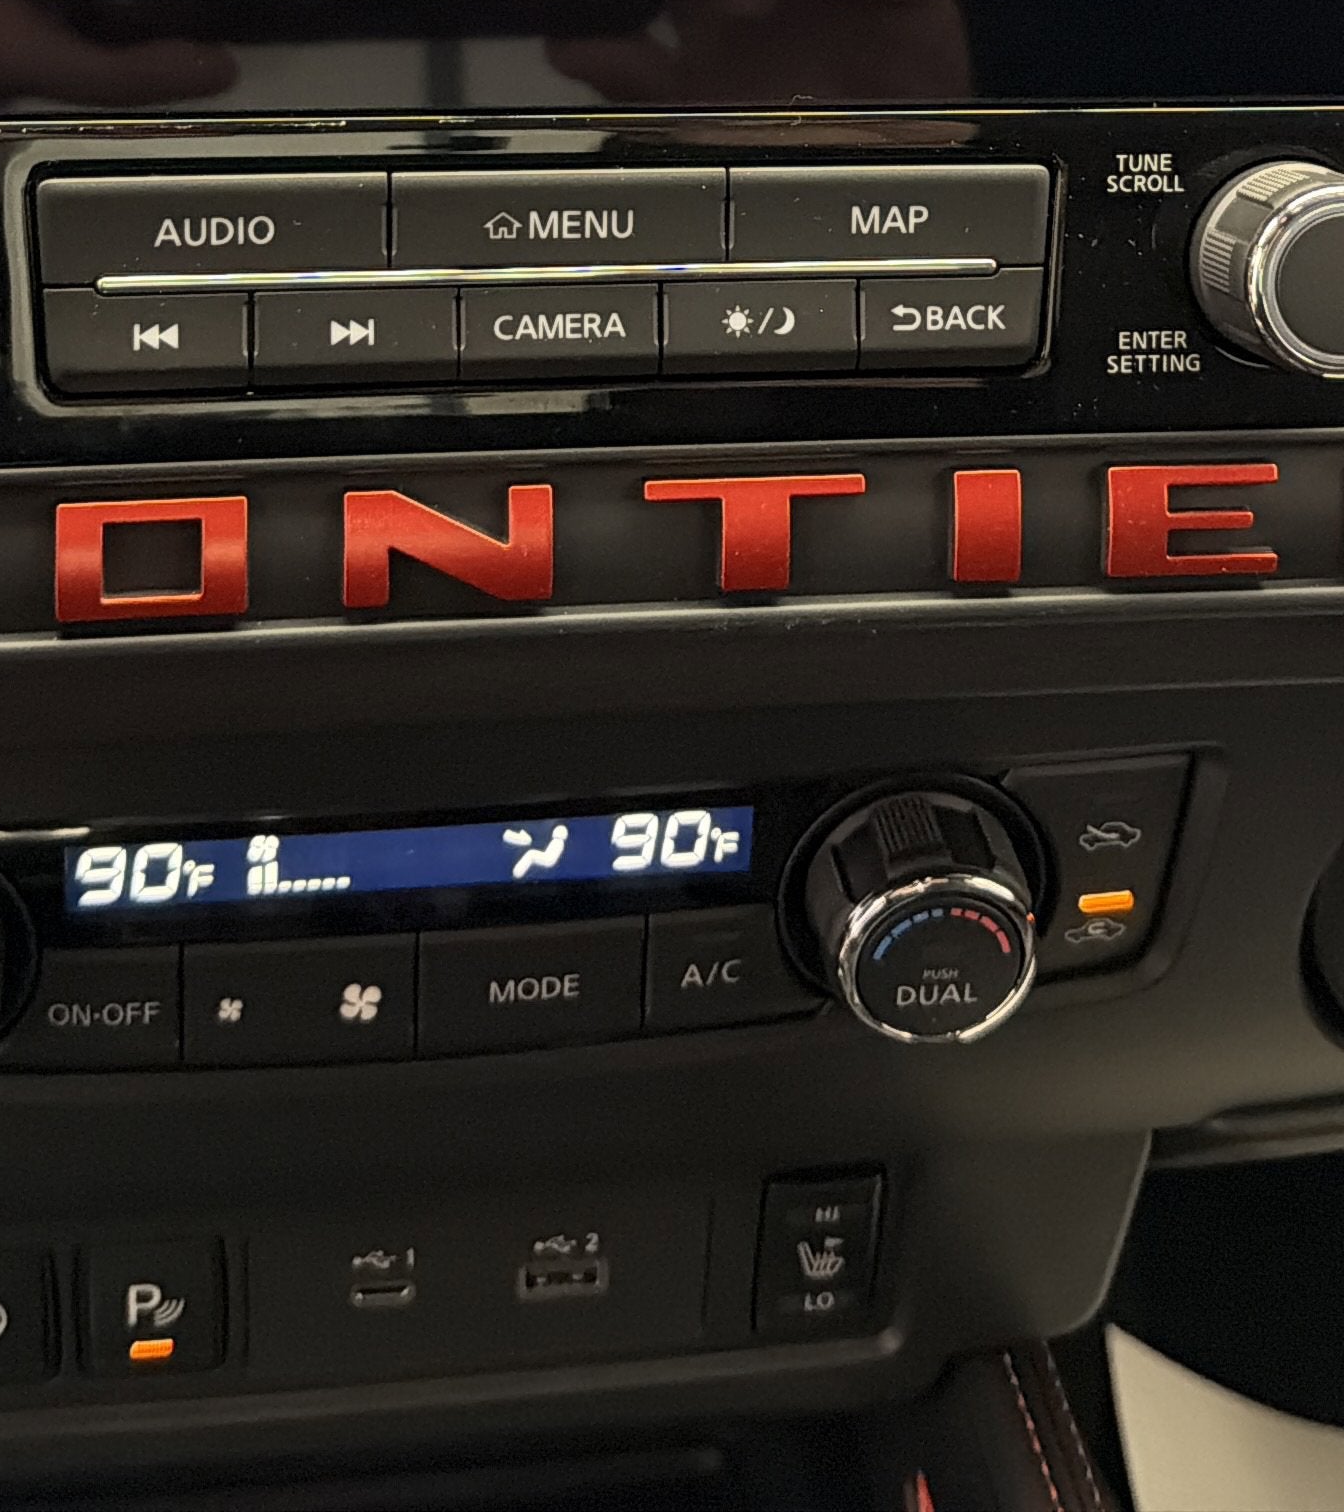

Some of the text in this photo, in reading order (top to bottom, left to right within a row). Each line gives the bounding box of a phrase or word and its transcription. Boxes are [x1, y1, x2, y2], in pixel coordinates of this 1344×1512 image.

[1116, 153, 1172, 174] TUNE
[1107, 173, 1184, 194] SCROLL
[155, 215, 276, 247] AUDIO
[528, 209, 635, 240] MENU
[851, 206, 929, 236] MAP
[493, 312, 626, 342] CAMERA
[925, 305, 1007, 332] BACK
[1118, 331, 1188, 351] ENTER
[1107, 353, 1201, 375] SETTING
[681, 958, 742, 989] A/C
[922, 968, 959, 981] PUSH
[489, 974, 580, 1004] MODE
[896, 981, 978, 1008] DUAL
[127, 1283, 161, 1327] P
[803, 1291, 835, 1312] LO
